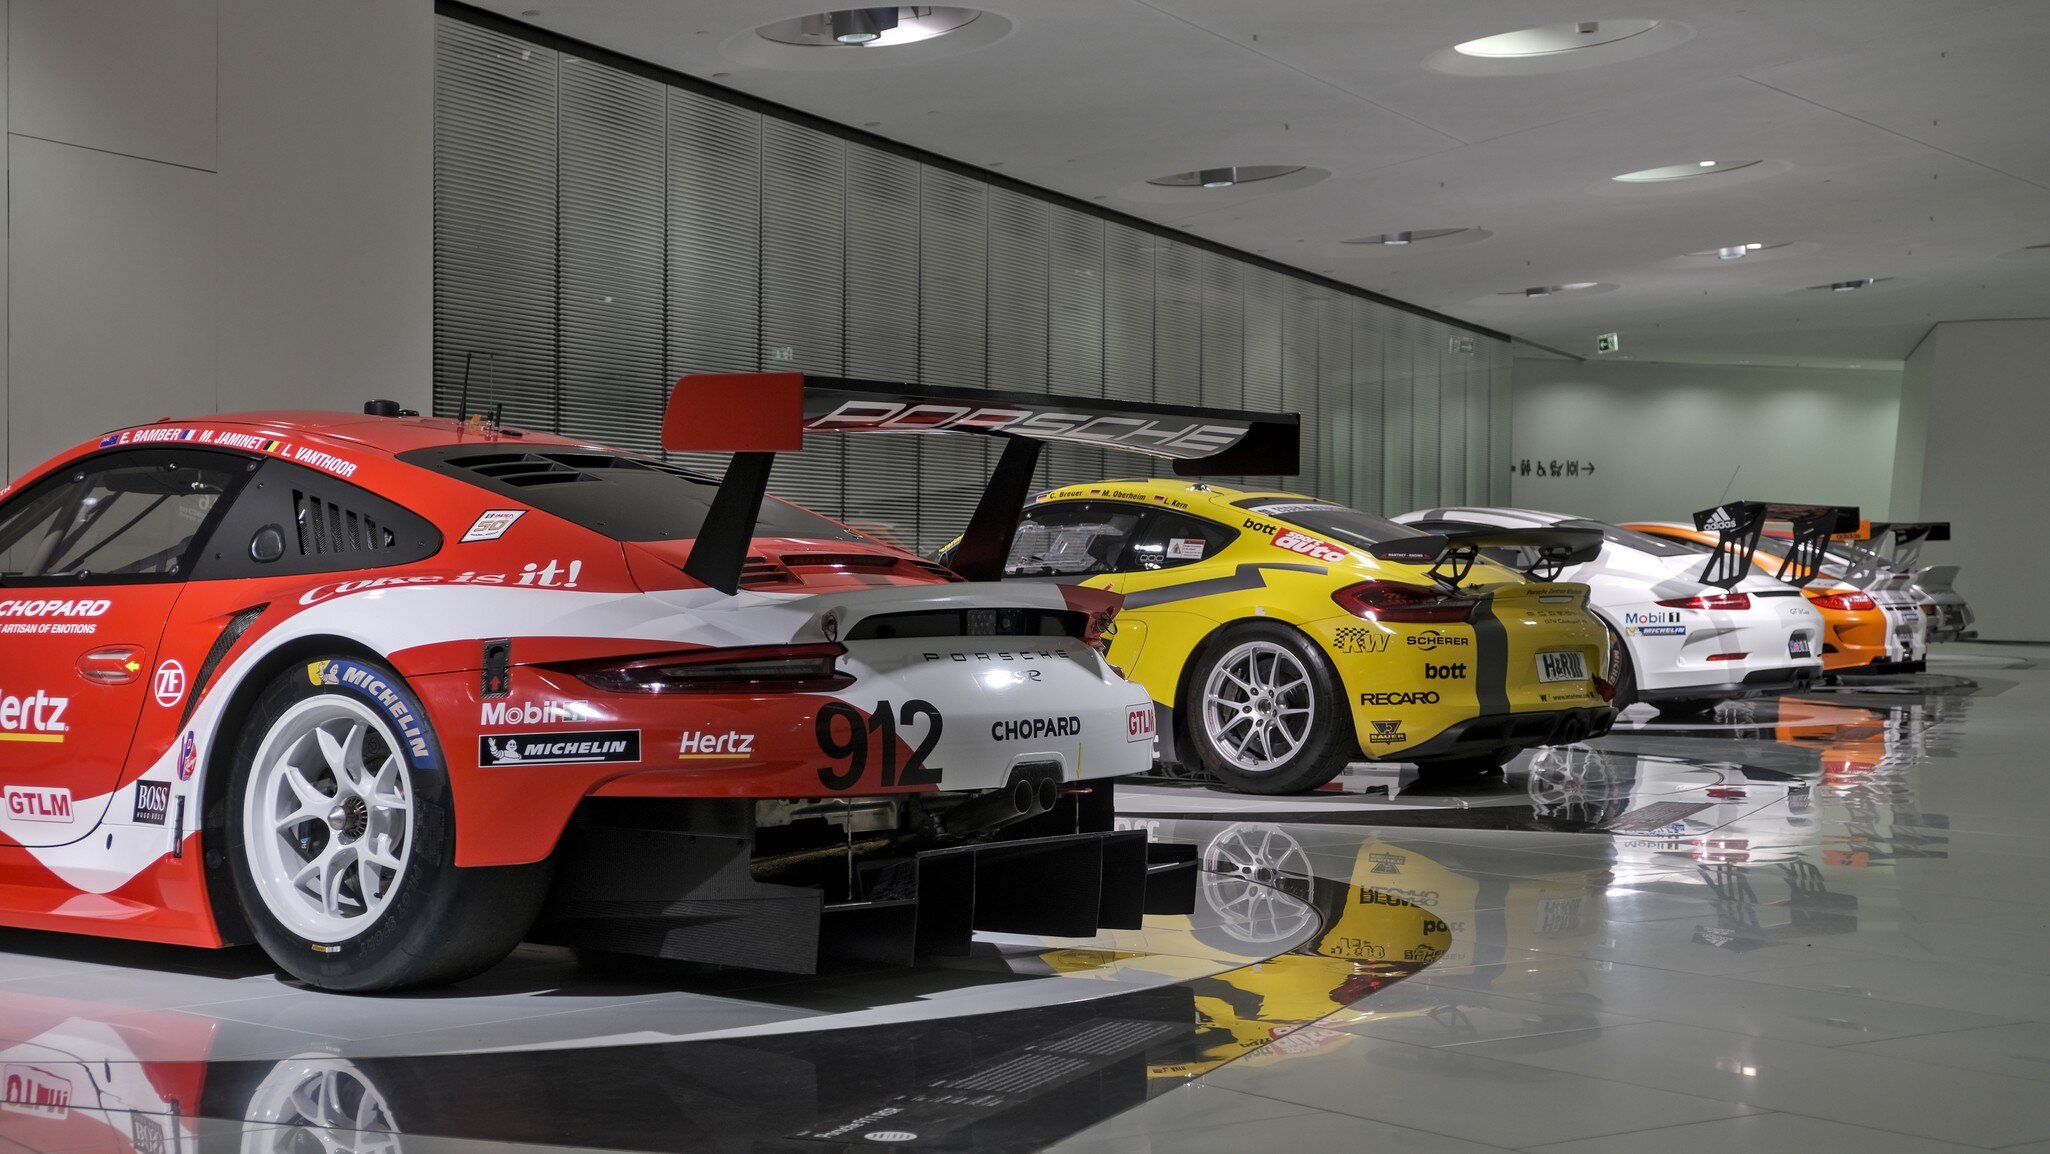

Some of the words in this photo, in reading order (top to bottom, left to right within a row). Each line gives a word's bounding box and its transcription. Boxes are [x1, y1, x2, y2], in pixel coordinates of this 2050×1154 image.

[806, 400, 1250, 451] PORSCHE
[119, 432, 129, 444] E.
[132, 428, 182, 442] BAMBER
[198, 429, 212, 443] M.
[214, 432, 266, 450] JAMINET
[281, 443, 291, 457] L.
[295, 446, 357, 477] VANTHOOR
[1059, 490, 1083, 498] Breuer
[1113, 490, 1146, 501] Oberheim
[1172, 499, 1188, 509] Kern
[474, 520, 509, 532] 50
[1243, 518, 1277, 535] bott
[1703, 518, 1737, 531] adidas
[1286, 531, 1324, 546] sport
[1275, 537, 1346, 562] auto
[449, 571, 505, 584] is
[512, 559, 582, 588] it!
[1626, 612, 1666, 624] Mobil
[1, 624, 37, 634] ARTISAN
[38, 624, 51, 634] OF
[51, 624, 97, 634] EMOTIONS
[1643, 627, 1685, 635] MICHELIN
[1343, 633, 1390, 653] KW
[1407, 636, 1469, 646] SCHERER
[923, 651, 1070, 662] PORSCHE
[1425, 663, 1467, 679] bott
[157, 669, 183, 697] ZF
[1361, 690, 1440, 705] RECARO
[0, 689, 68, 732] ertz
[342, 667, 429, 758] MICHELIN
[480, 700, 557, 725] Mobil
[991, 715, 1081, 741] CHOPARD
[524, 740, 627, 755] MICHELIN
[679, 731, 754, 753] Hertz
[815, 699, 943, 791] 912
[8, 791, 70, 816] GTLM
[138, 785, 167, 811] BOSS
